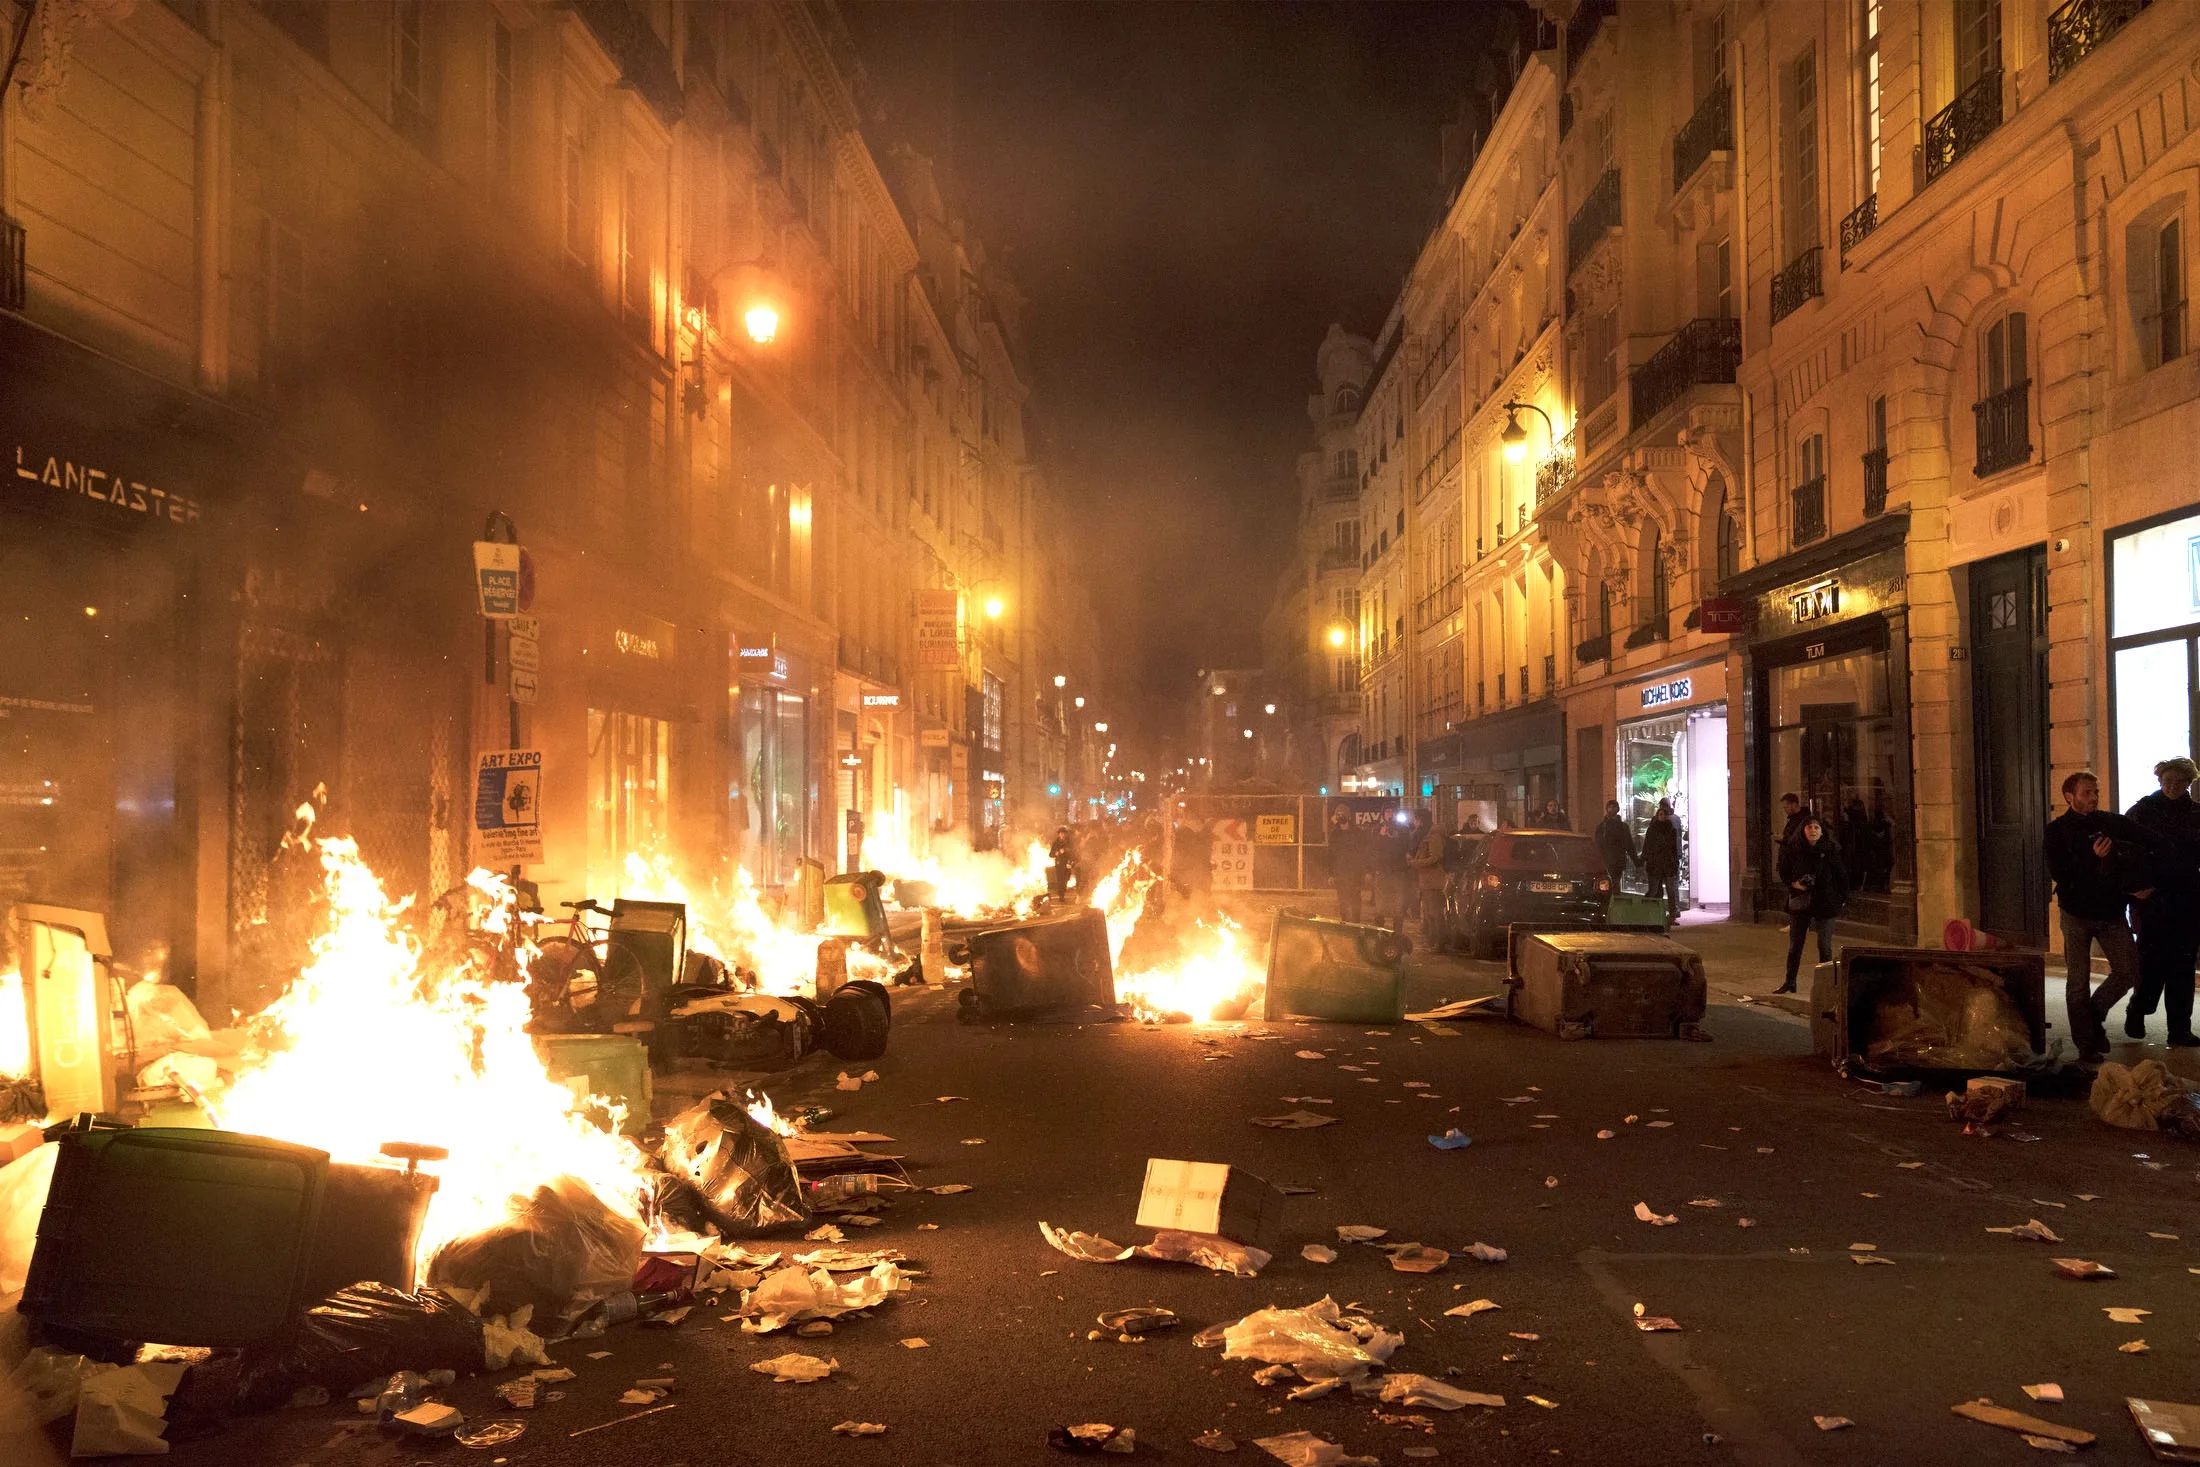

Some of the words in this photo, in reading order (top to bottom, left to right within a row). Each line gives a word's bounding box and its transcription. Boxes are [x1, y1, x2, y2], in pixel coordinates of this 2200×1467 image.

[16, 446, 201, 523] LANCASTER
[1889, 576, 1904, 593] 281
[1641, 684, 1668, 707] MICHAEL
[1669, 678, 1691, 700] KORS
[481, 754, 505, 768] ART
[508, 752, 542, 766] EXPO
